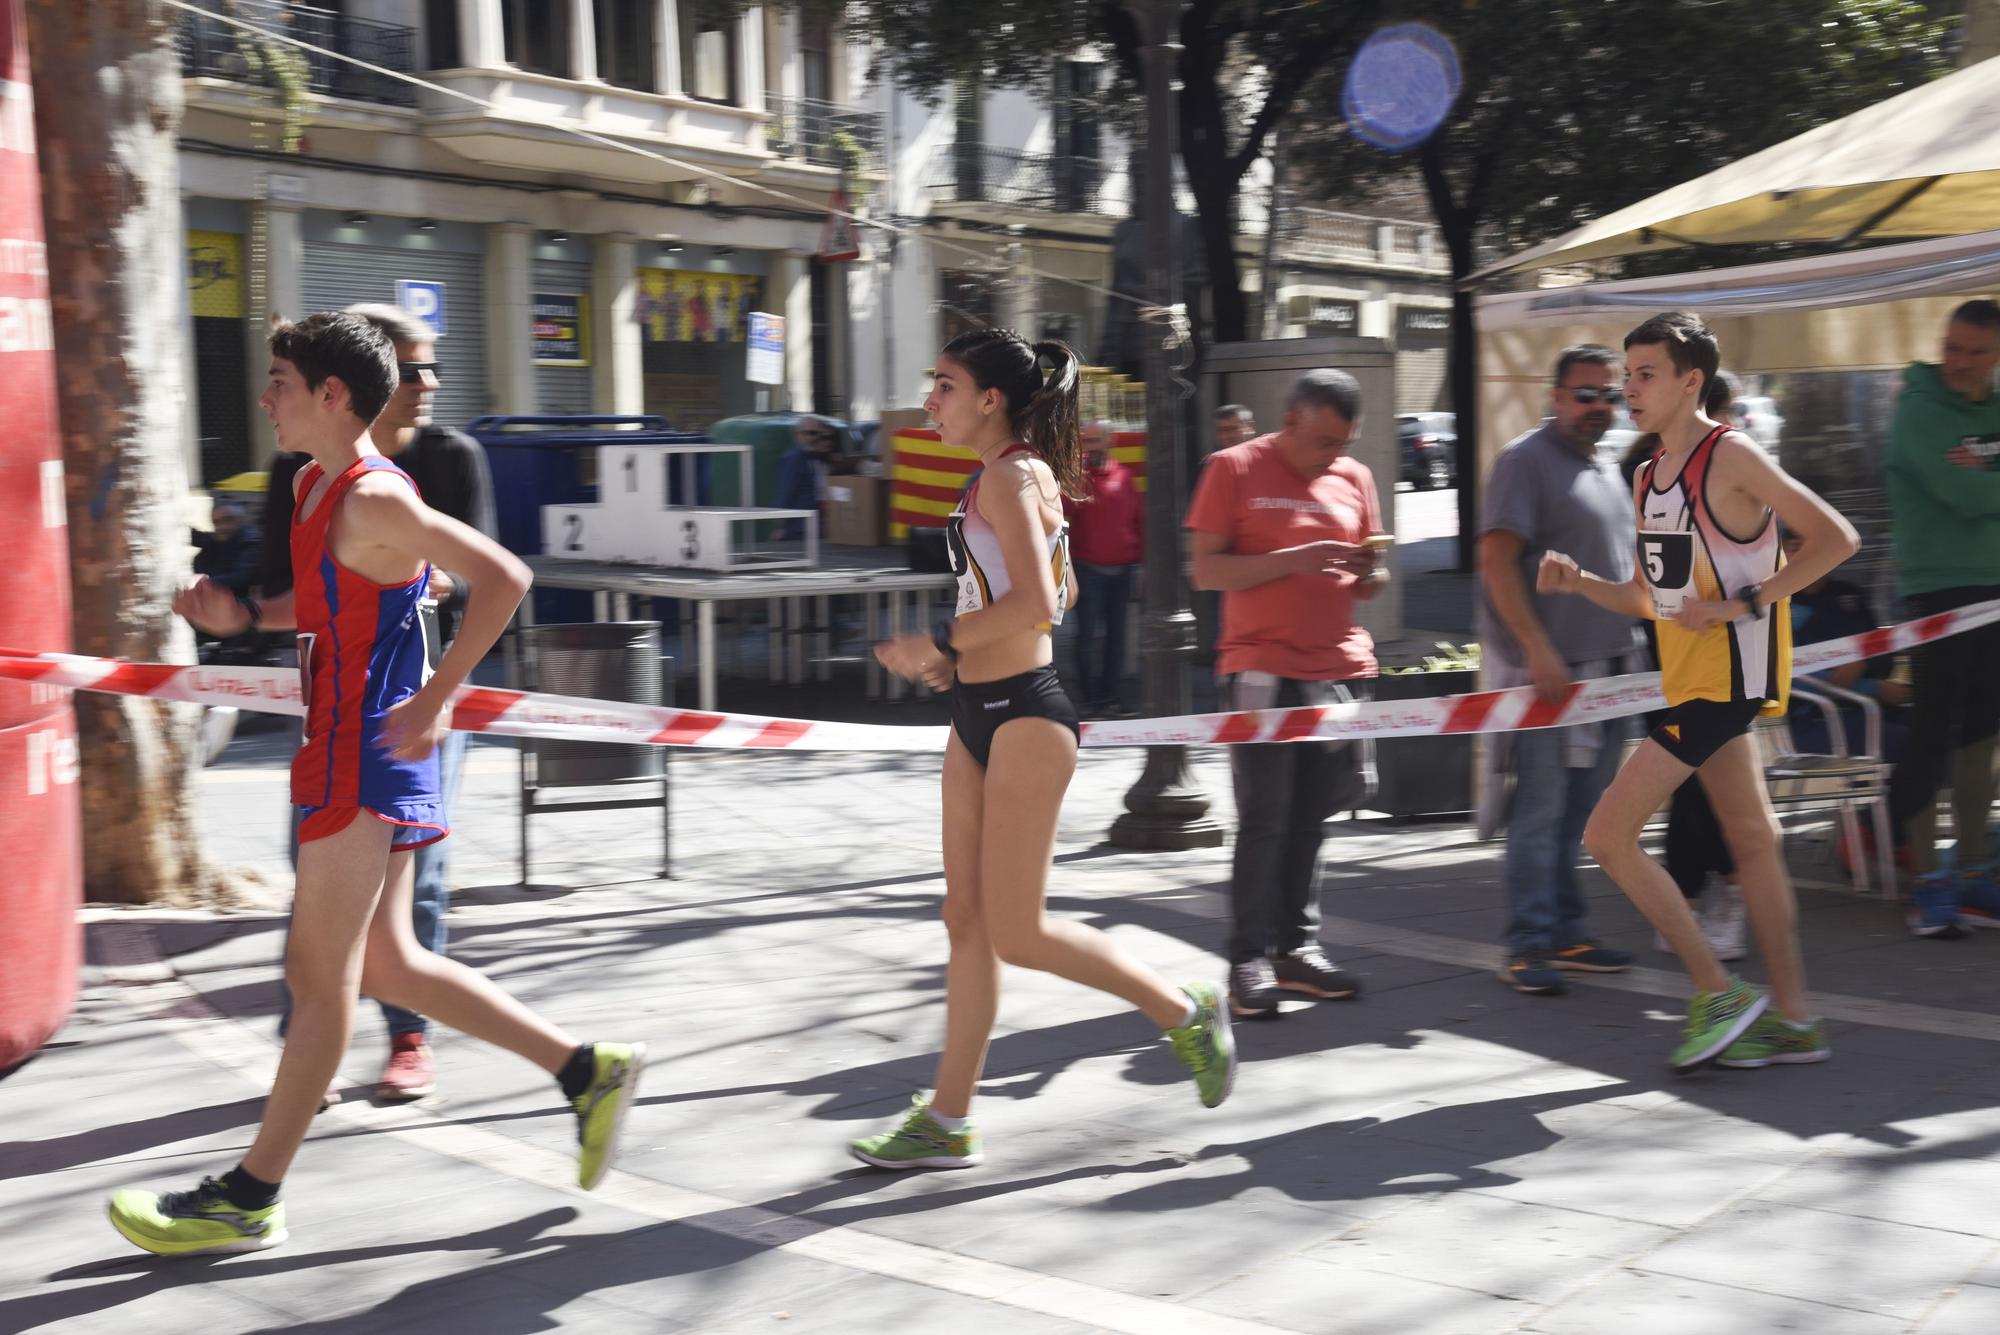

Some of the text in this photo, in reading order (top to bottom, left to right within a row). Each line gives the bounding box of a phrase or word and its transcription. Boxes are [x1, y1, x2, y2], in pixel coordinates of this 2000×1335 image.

[404, 288, 438, 320] P
[621, 453, 639, 493] 1
[564, 513, 585, 552] 2
[679, 519, 698, 561] 3
[1644, 542, 1664, 583] 5
